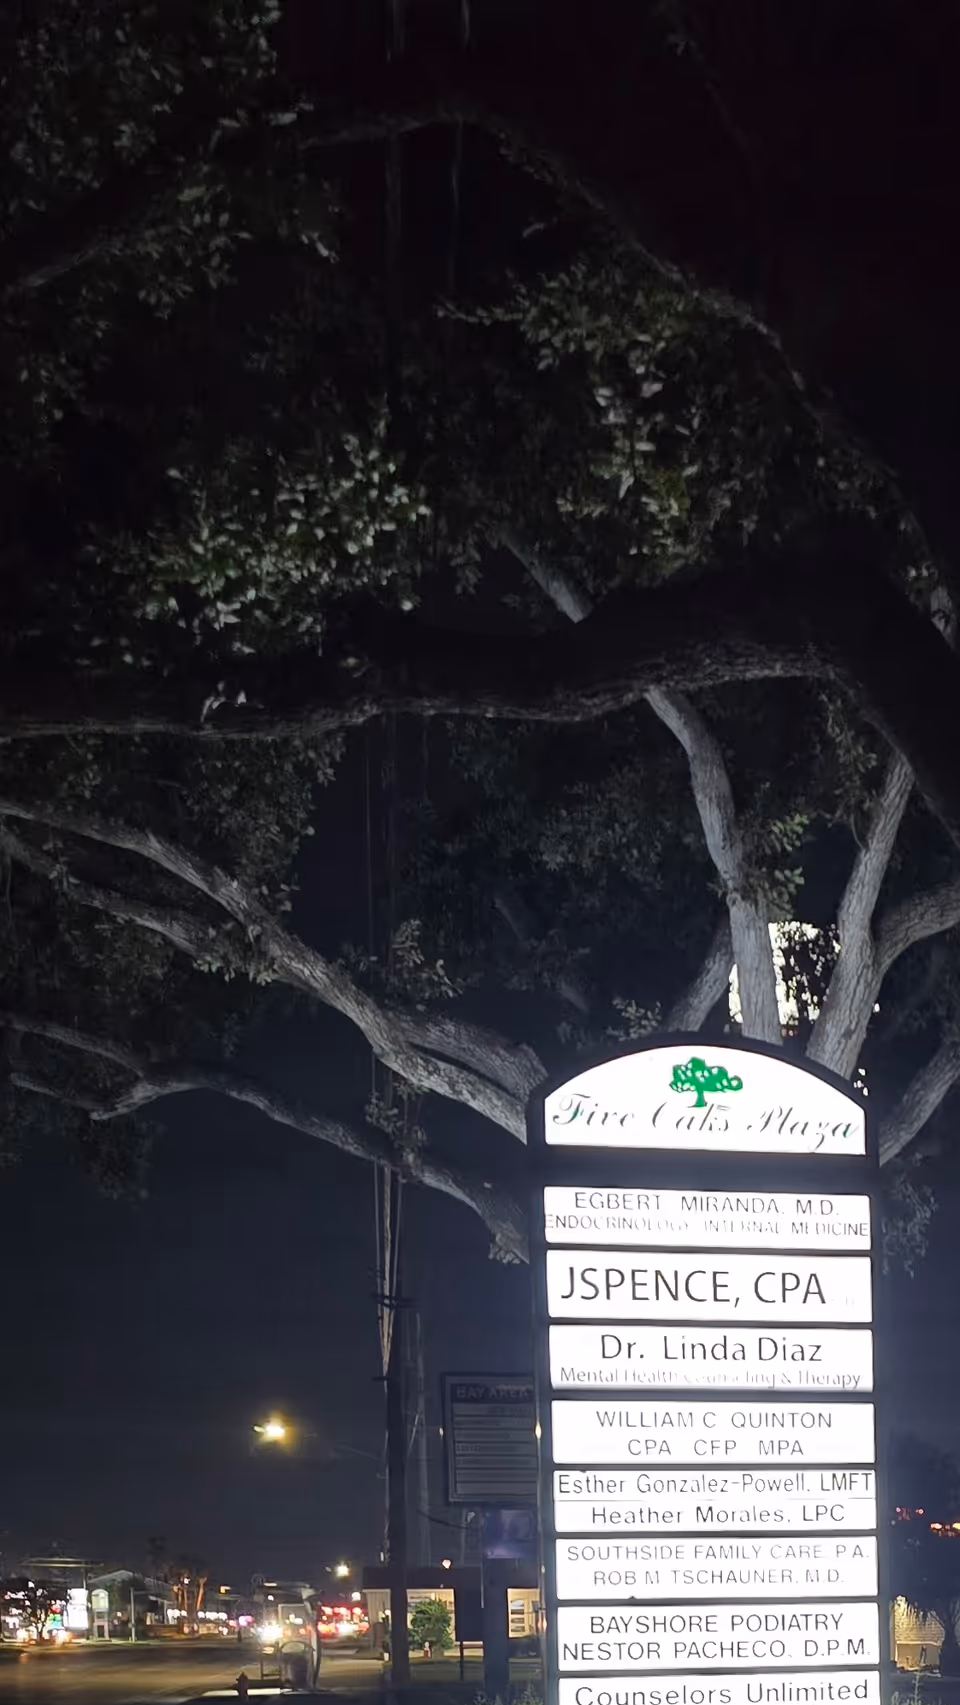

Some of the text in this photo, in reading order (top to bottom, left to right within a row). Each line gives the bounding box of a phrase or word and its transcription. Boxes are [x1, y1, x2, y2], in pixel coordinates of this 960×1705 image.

[552, 1093, 635, 1127] Five
[746, 1105, 859, 1152] Plaza
[575, 1191, 660, 1210] EGBERT
[796, 1199, 838, 1215] M.D.
[561, 1267, 826, 1308] JSPENCE, CPA
[601, 1334, 822, 1361] Dr. Linda Diaz
[558, 1366, 619, 1384] Mental
[596, 1411, 693, 1427] WILLIAM
[731, 1412, 831, 1428] QUINTON
[628, 1439, 803, 1455] CPA CFP MPA
[559, 1474, 625, 1494] Esther
[821, 1473, 872, 1491] LMFT
[593, 1507, 682, 1524] Heather
[803, 1504, 844, 1521] LPC
[568, 1545, 684, 1561] SOUTHSIDE
[695, 1545, 761, 1559] FAMILY
[770, 1545, 821, 1559] CARE
[594, 1571, 636, 1586] ROB
[806, 1569, 843, 1582] M.D.
[590, 1613, 843, 1634] BAYSHORE PODIATRY
[564, 1642, 660, 1660] NESTOR
[805, 1638, 870, 1656] D.P.M.
[747, 1679, 867, 1703] Unlimited
